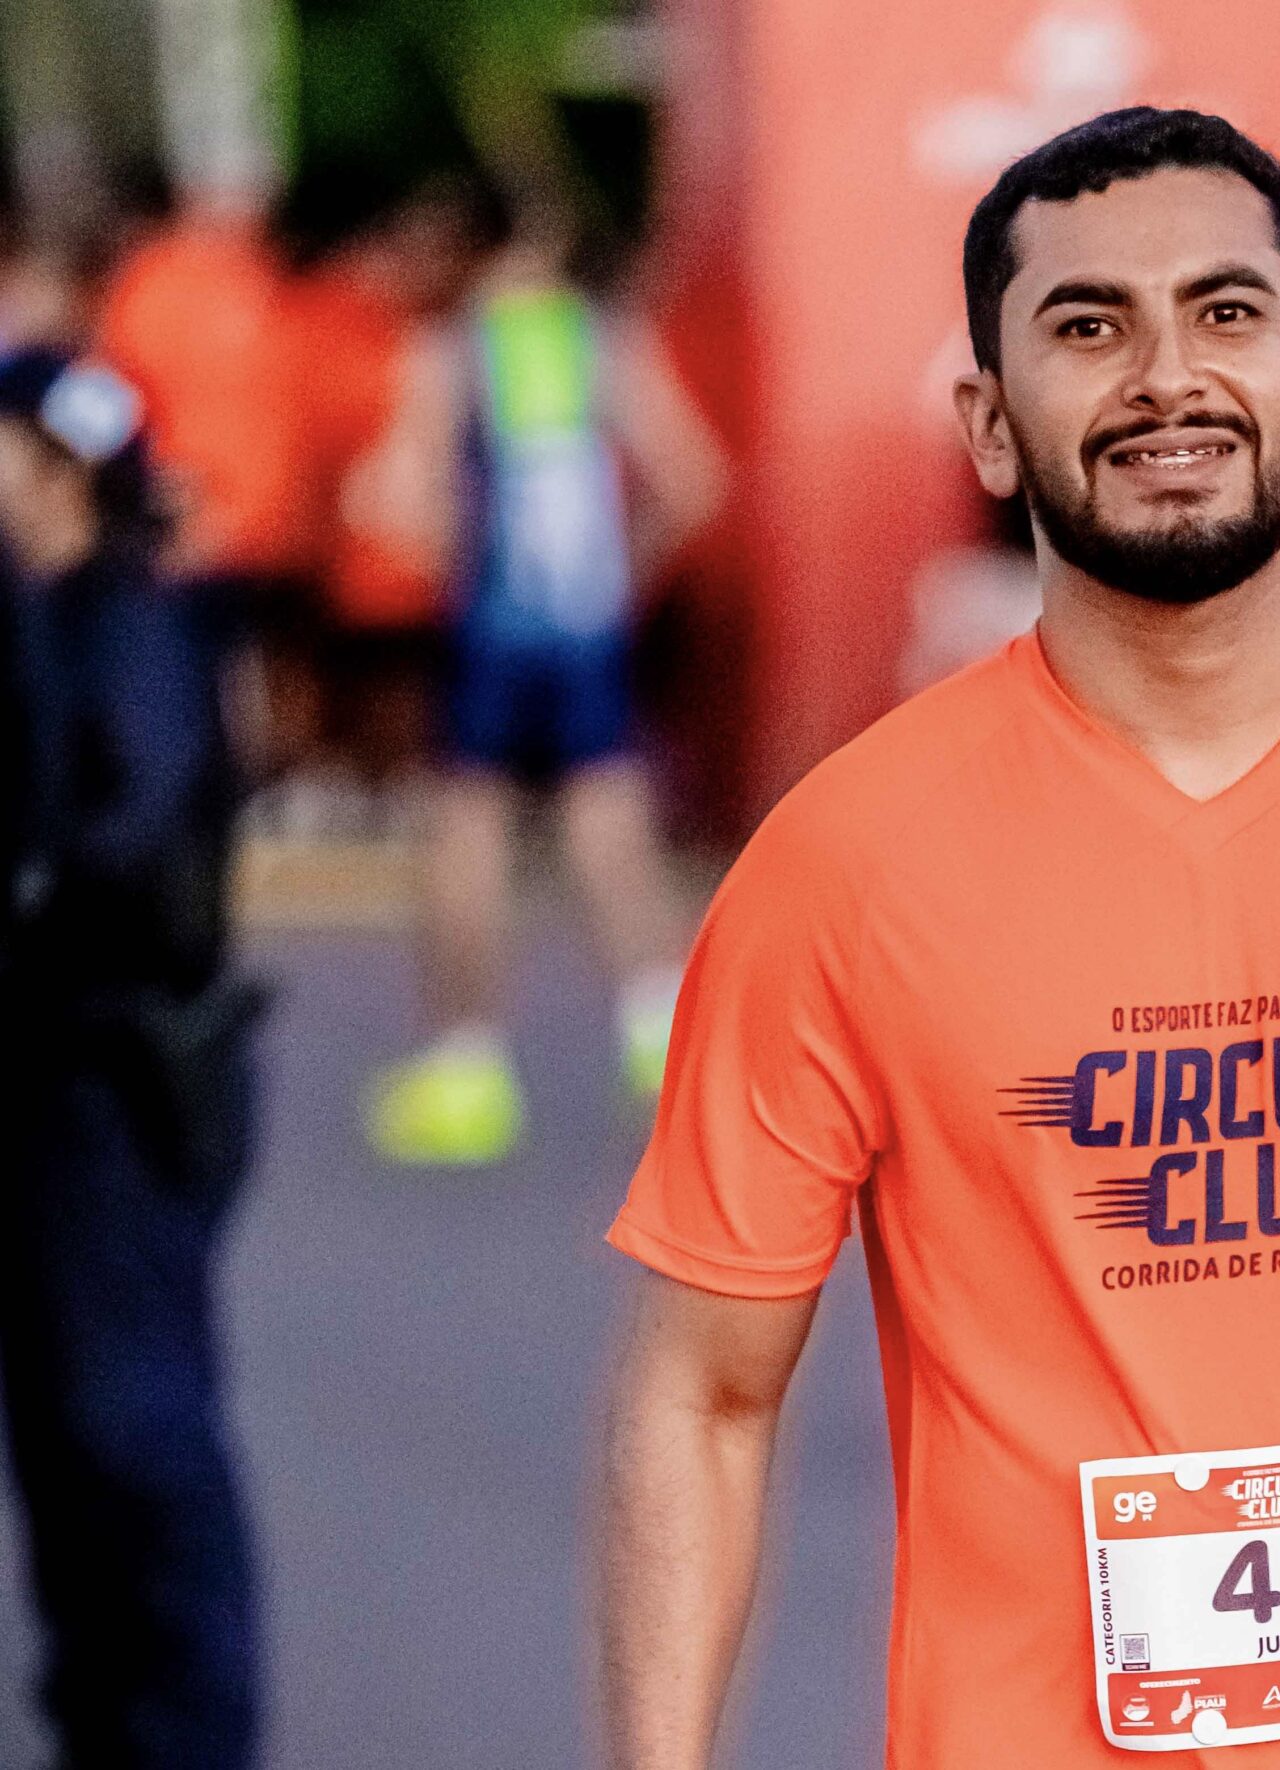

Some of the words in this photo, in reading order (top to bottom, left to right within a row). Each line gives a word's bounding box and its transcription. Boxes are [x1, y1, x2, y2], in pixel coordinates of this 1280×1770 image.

[1112, 1006, 1125, 1033] O
[1131, 1002, 1214, 1034] ESPORTE
[1217, 998, 1253, 1027] FAZ
[1101, 1256, 1220, 1291] CORRIDA
[1228, 1252, 1263, 1278] DE
[1113, 1490, 1158, 1524] ge
[1098, 1547, 1109, 1585] 10KM
[1101, 1589, 1116, 1666] CATEGORIA
